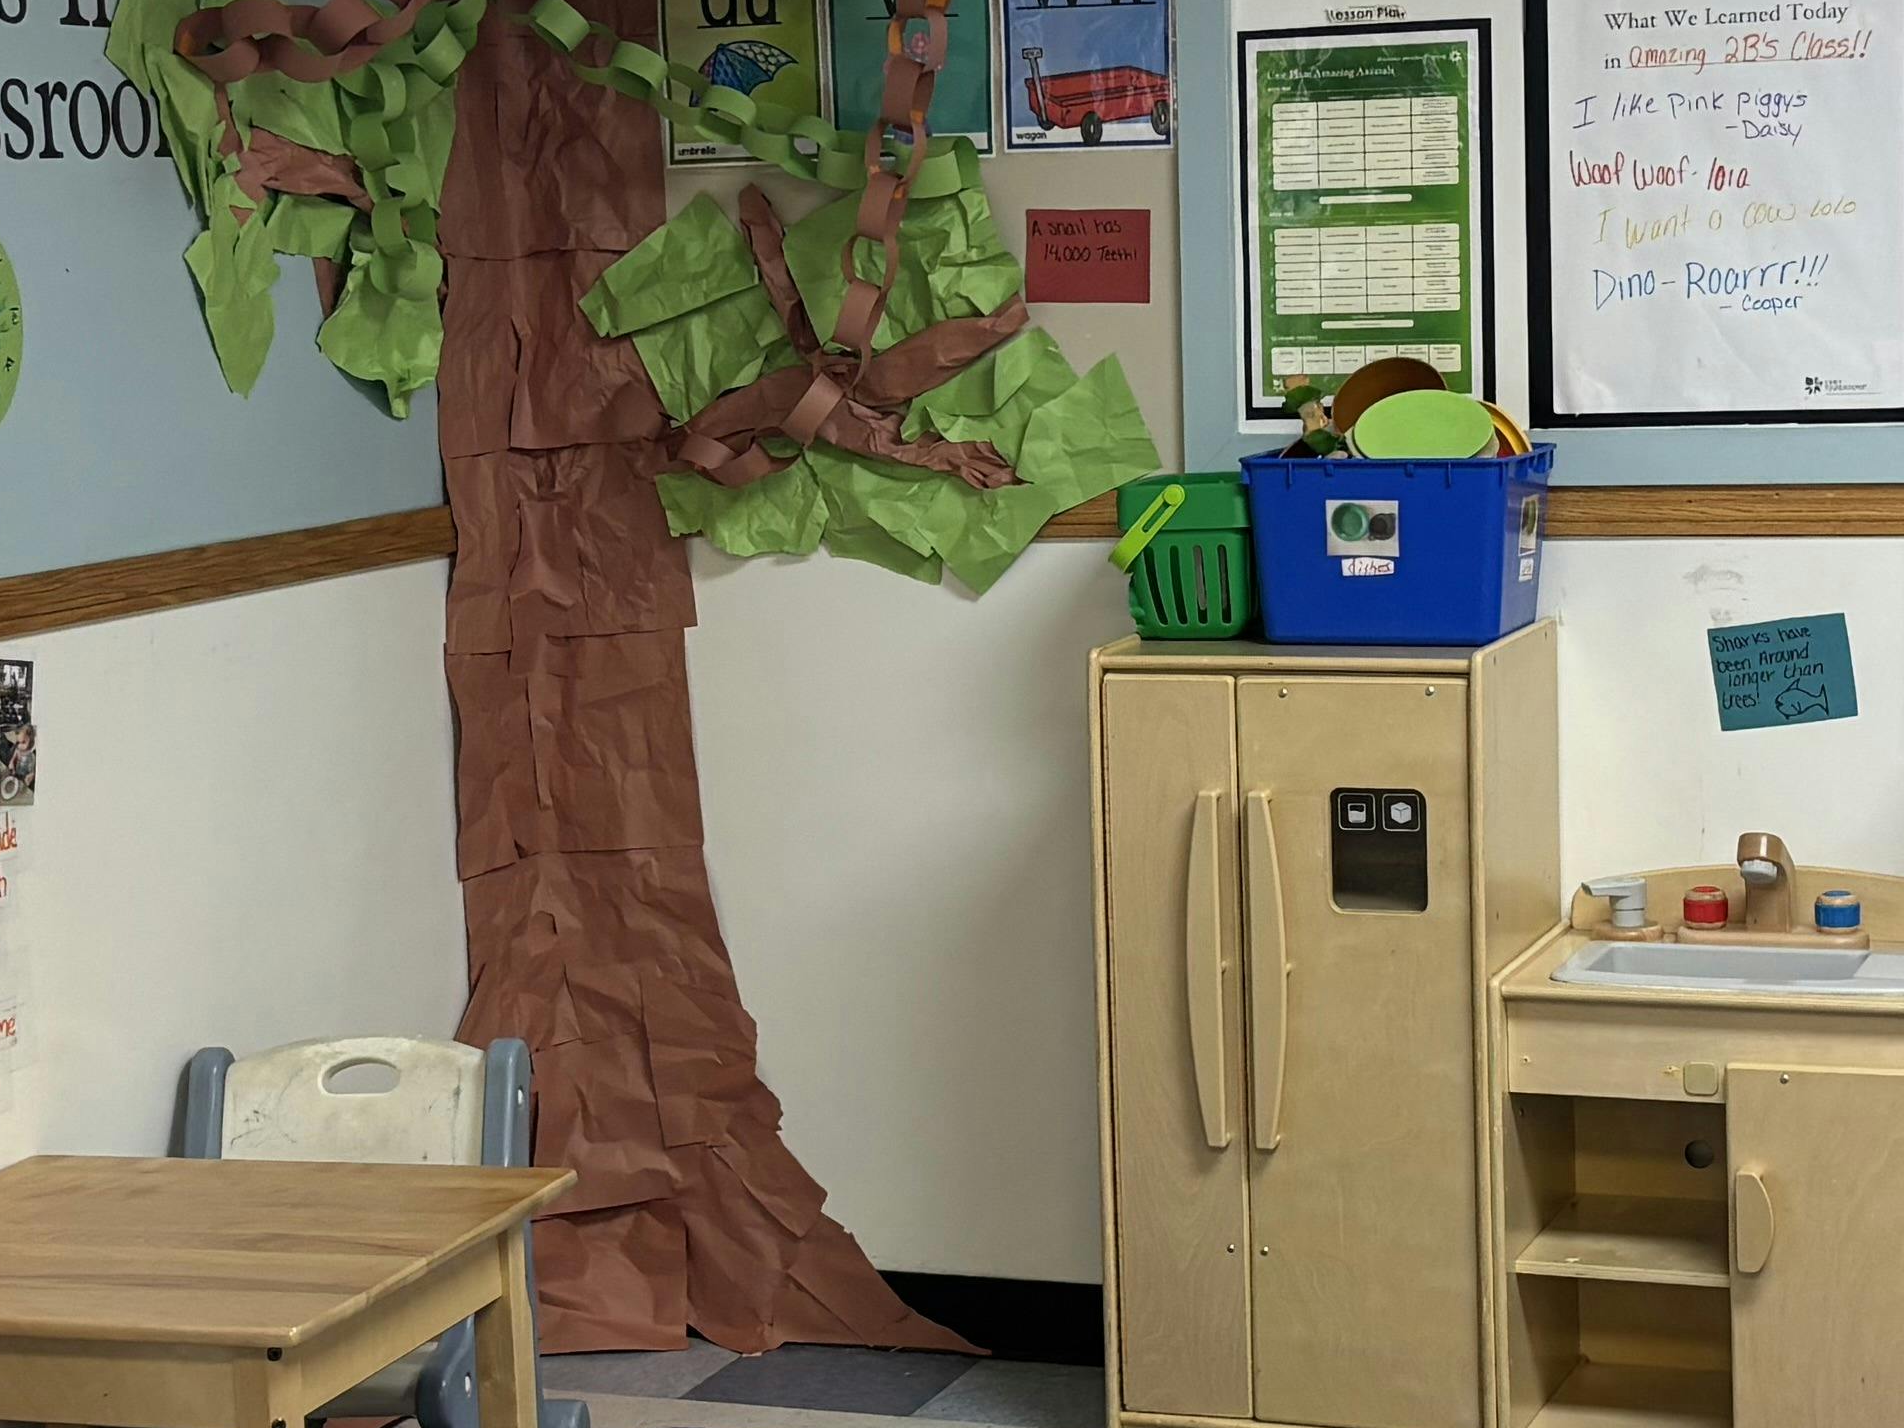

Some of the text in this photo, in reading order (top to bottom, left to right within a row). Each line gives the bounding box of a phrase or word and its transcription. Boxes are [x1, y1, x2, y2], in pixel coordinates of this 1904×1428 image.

[1604, 2, 1849, 31] What We Learned Today
[1604, 53, 1622, 71] in
[1572, 94, 1597, 130] I
[1613, 91, 1660, 116] like
[1015, 130, 1047, 143] wagon
[1031, 217, 1122, 239] A snail has
[1625, 203, 1692, 251] want
[1777, 626, 1812, 643] have
[1716, 657, 1752, 673] been
[1728, 661, 1824, 692] longer than
